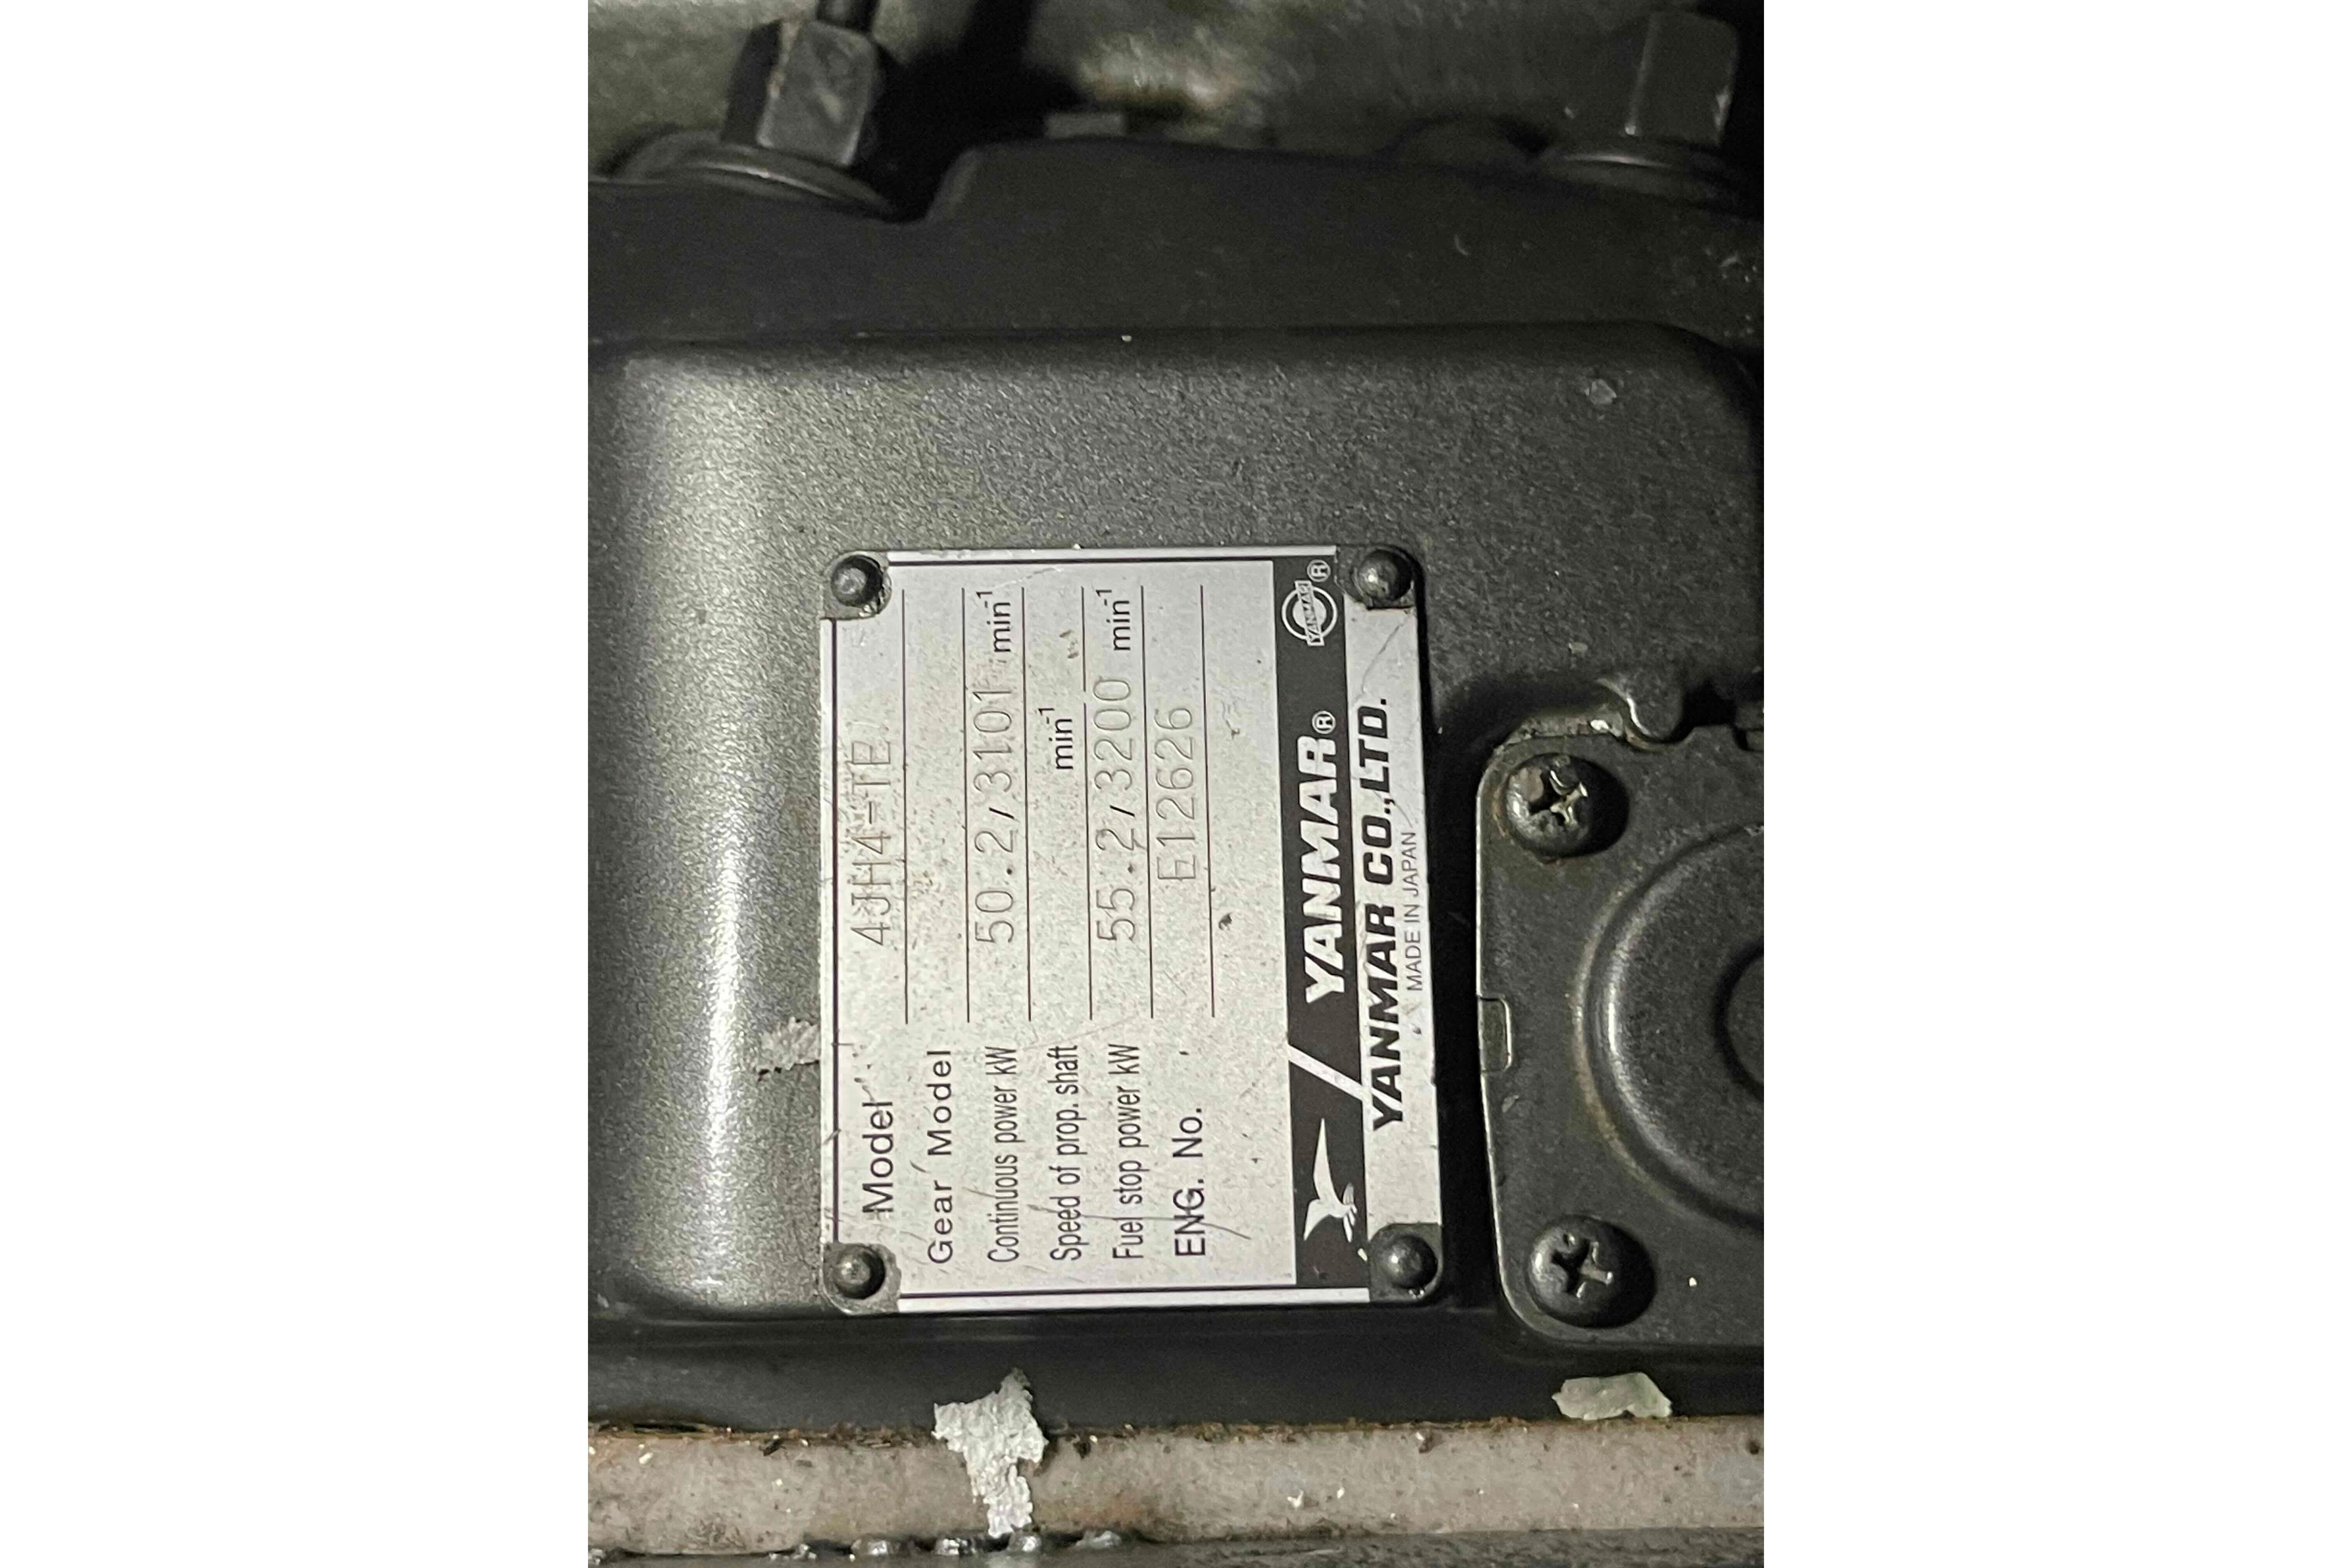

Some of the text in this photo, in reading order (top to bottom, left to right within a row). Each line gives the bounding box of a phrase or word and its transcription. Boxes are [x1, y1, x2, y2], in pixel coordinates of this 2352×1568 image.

[1401, 831, 1423, 991] MADE IN JAPAN
[850, 740, 894, 1213] Model 4JH4-TE
[1153, 706, 1206, 1256] ENG. No. E12626
[1365, 903, 1403, 1131] YANMAR
[984, 1045, 1017, 1075] kW
[1046, 1044, 1079, 1095] shaft
[1107, 1043, 1140, 1074] kW
[992, 1085, 1025, 1143] power
[1056, 1102, 1087, 1155] prop.
[1116, 1086, 1148, 1148] power
[926, 1049, 953, 1264] Gear Model
[1048, 1166, 1081, 1185] of
[1114, 1160, 1149, 1204] stop
[986, 1153, 1020, 1262] Continuous
[1049, 1195, 1088, 1260] Speed
[1112, 1216, 1144, 1259] Fuel
